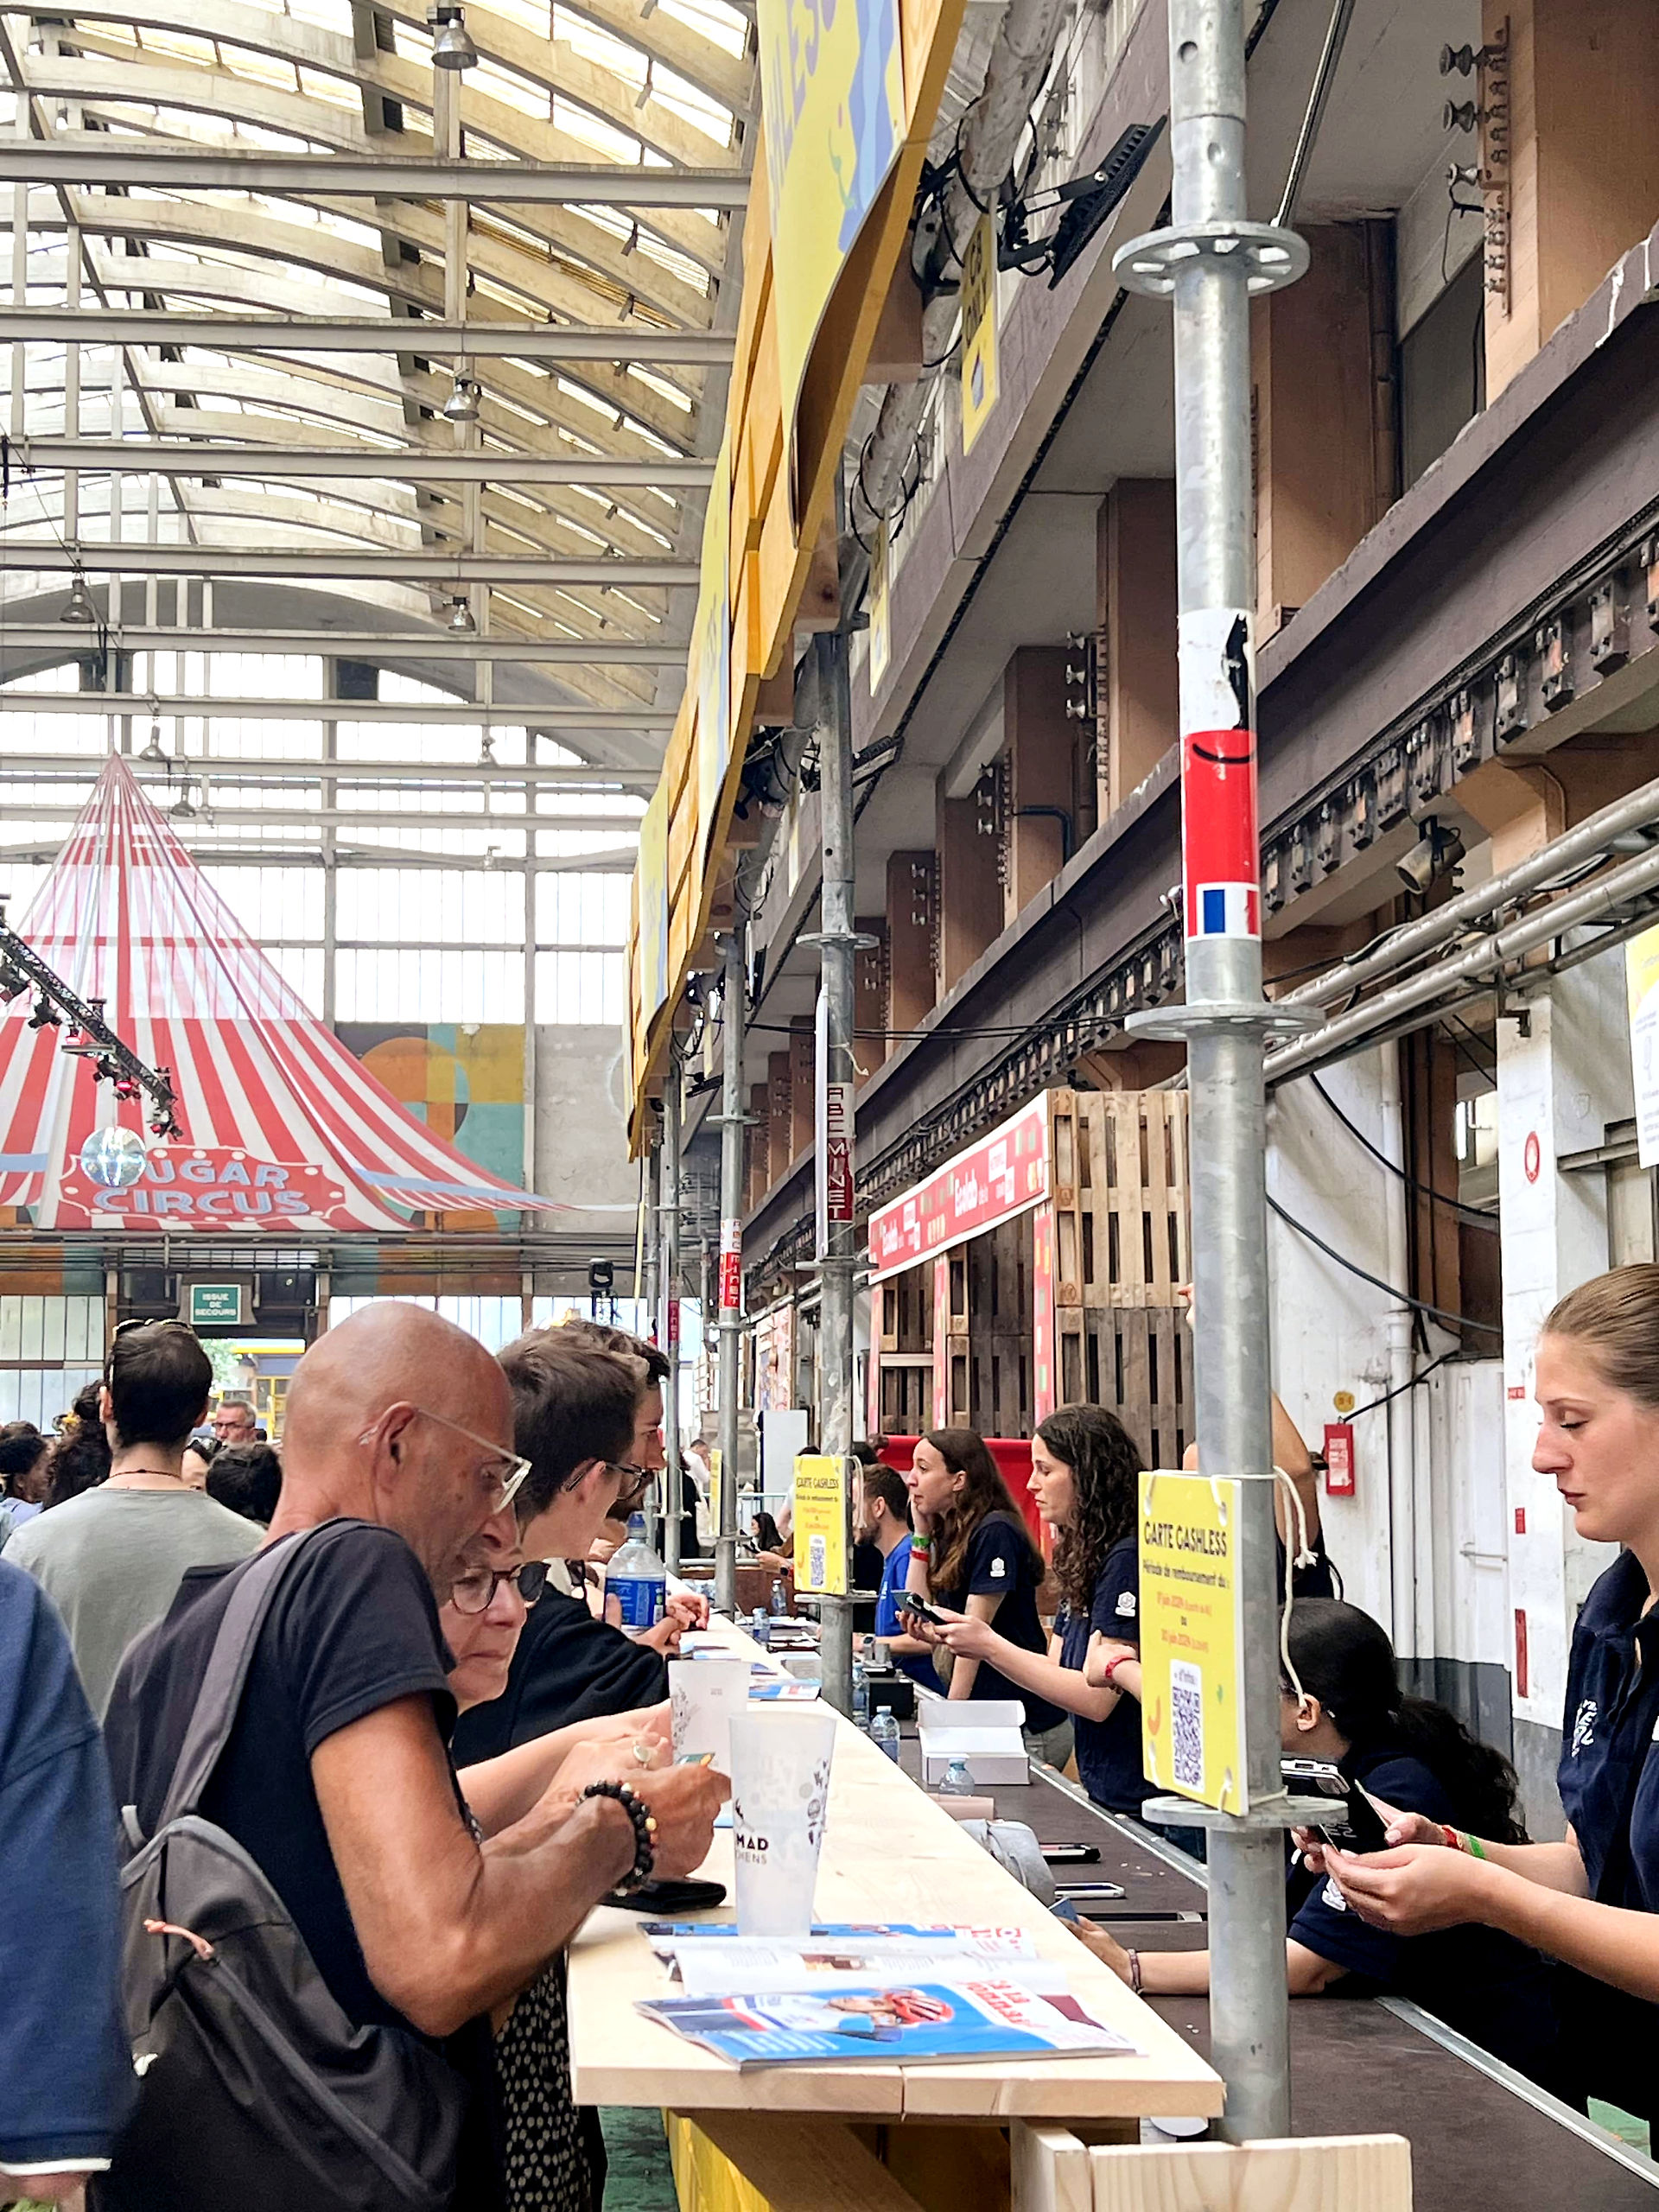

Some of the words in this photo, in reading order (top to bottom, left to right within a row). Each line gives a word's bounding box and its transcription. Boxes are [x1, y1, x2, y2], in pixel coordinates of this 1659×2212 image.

[145, 1160, 289, 1189] UGAR
[828, 1141, 846, 1219] MINET
[92, 1188, 310, 1215] CIRCUS
[201, 1292, 229, 1300] ISSUE
[194, 1307, 237, 1316] SECOURS
[1144, 1520, 1173, 1548] CARTE
[1176, 1524, 1227, 1557] CASHLESS
